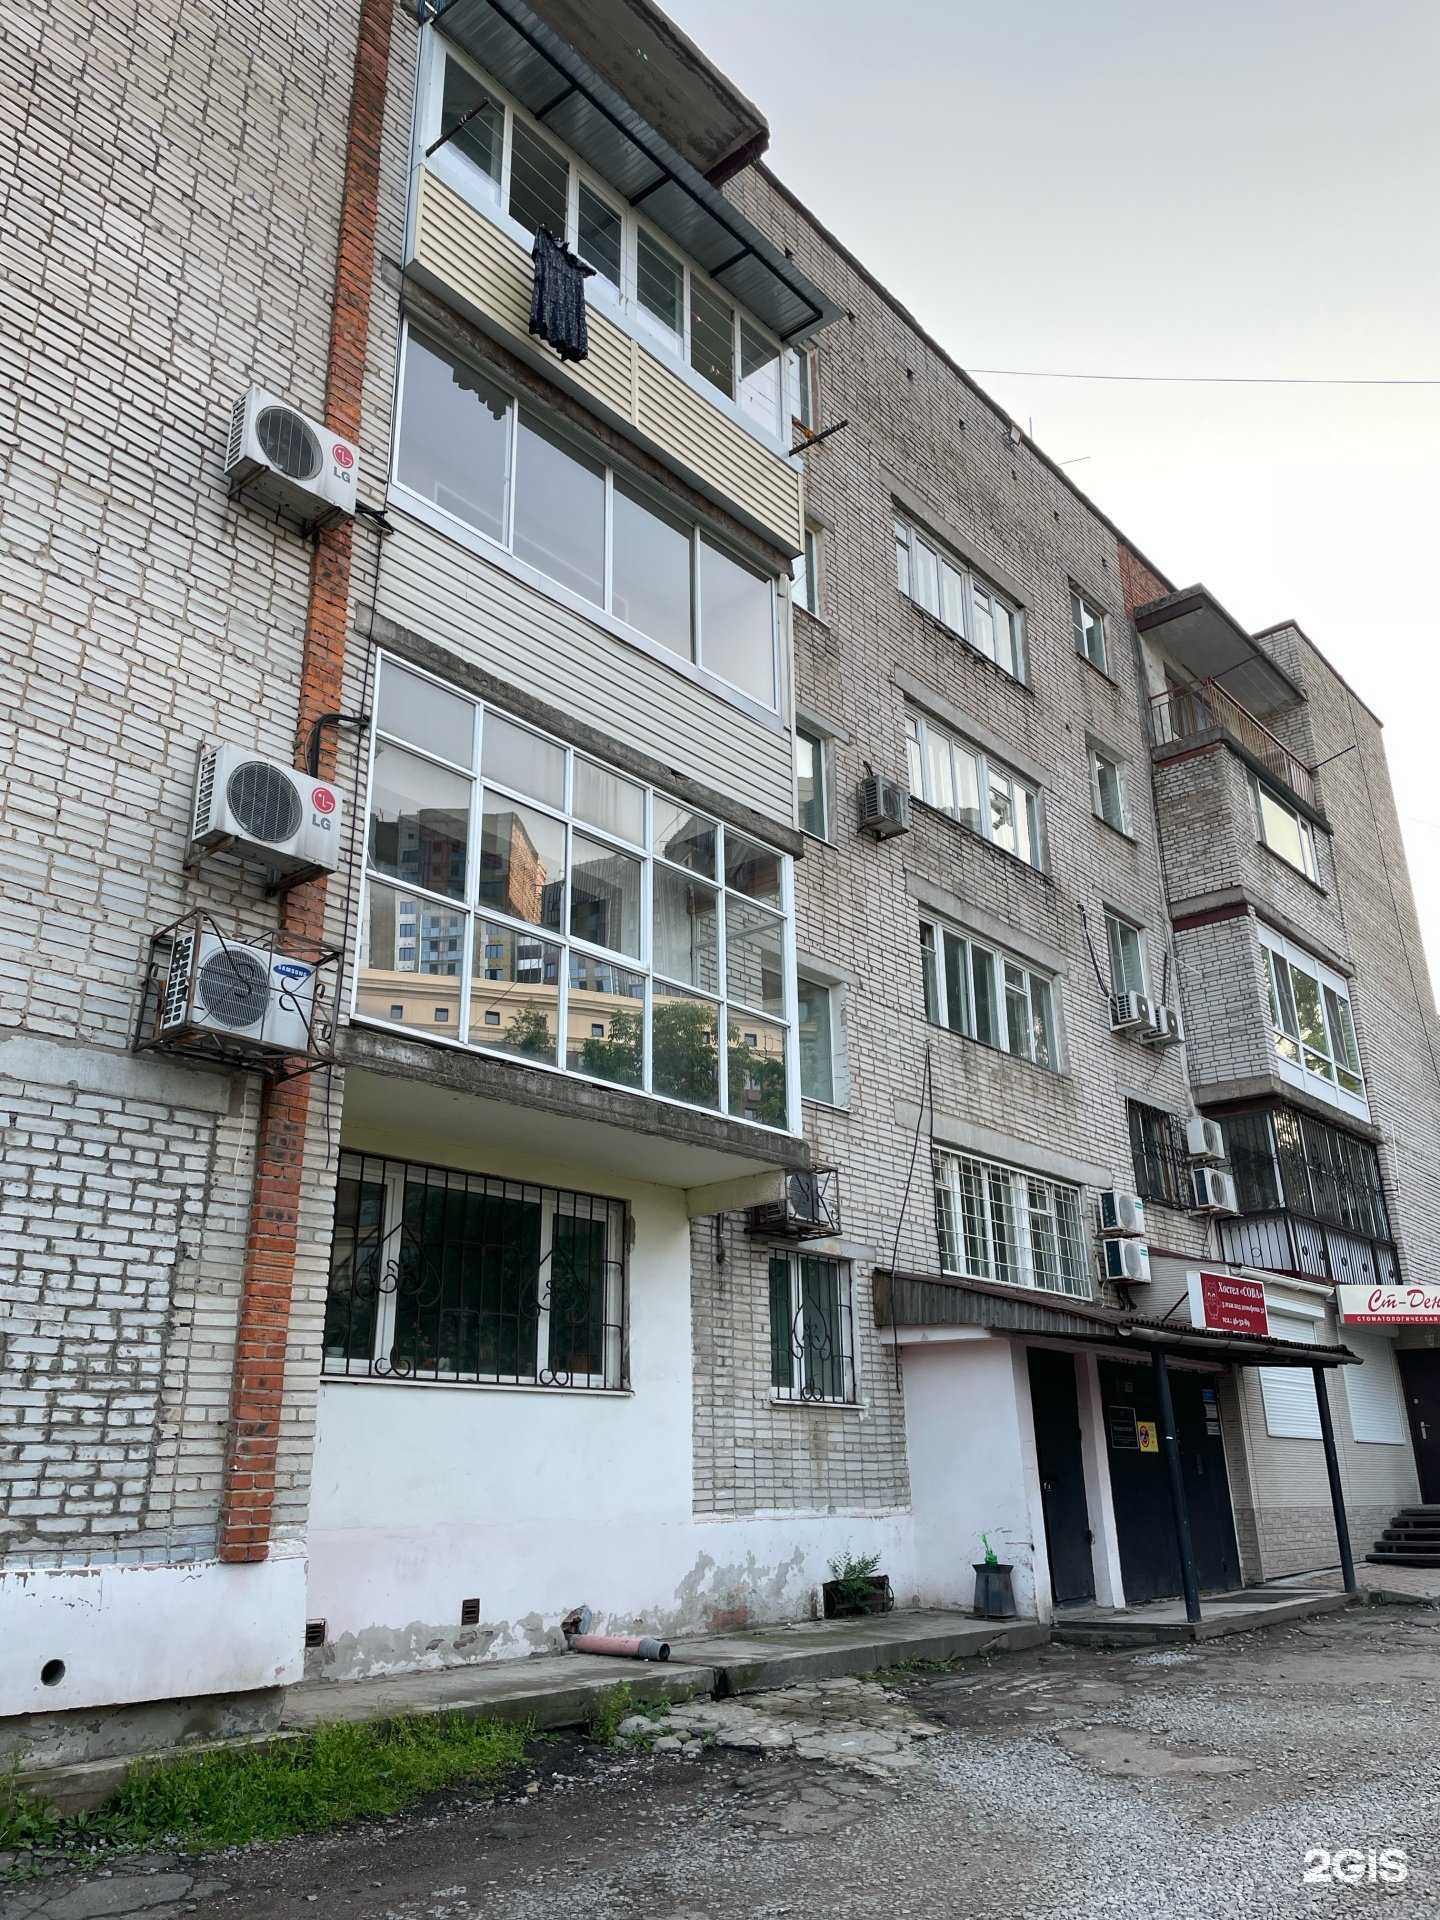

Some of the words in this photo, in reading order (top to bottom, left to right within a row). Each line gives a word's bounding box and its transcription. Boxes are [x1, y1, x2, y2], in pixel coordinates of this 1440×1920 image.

[334, 466, 351, 484] LG
[312, 813, 332, 831] LG
[1218, 1282, 1239, 1295] Хостел
[1240, 1287, 1262, 1299] «СОВА»
